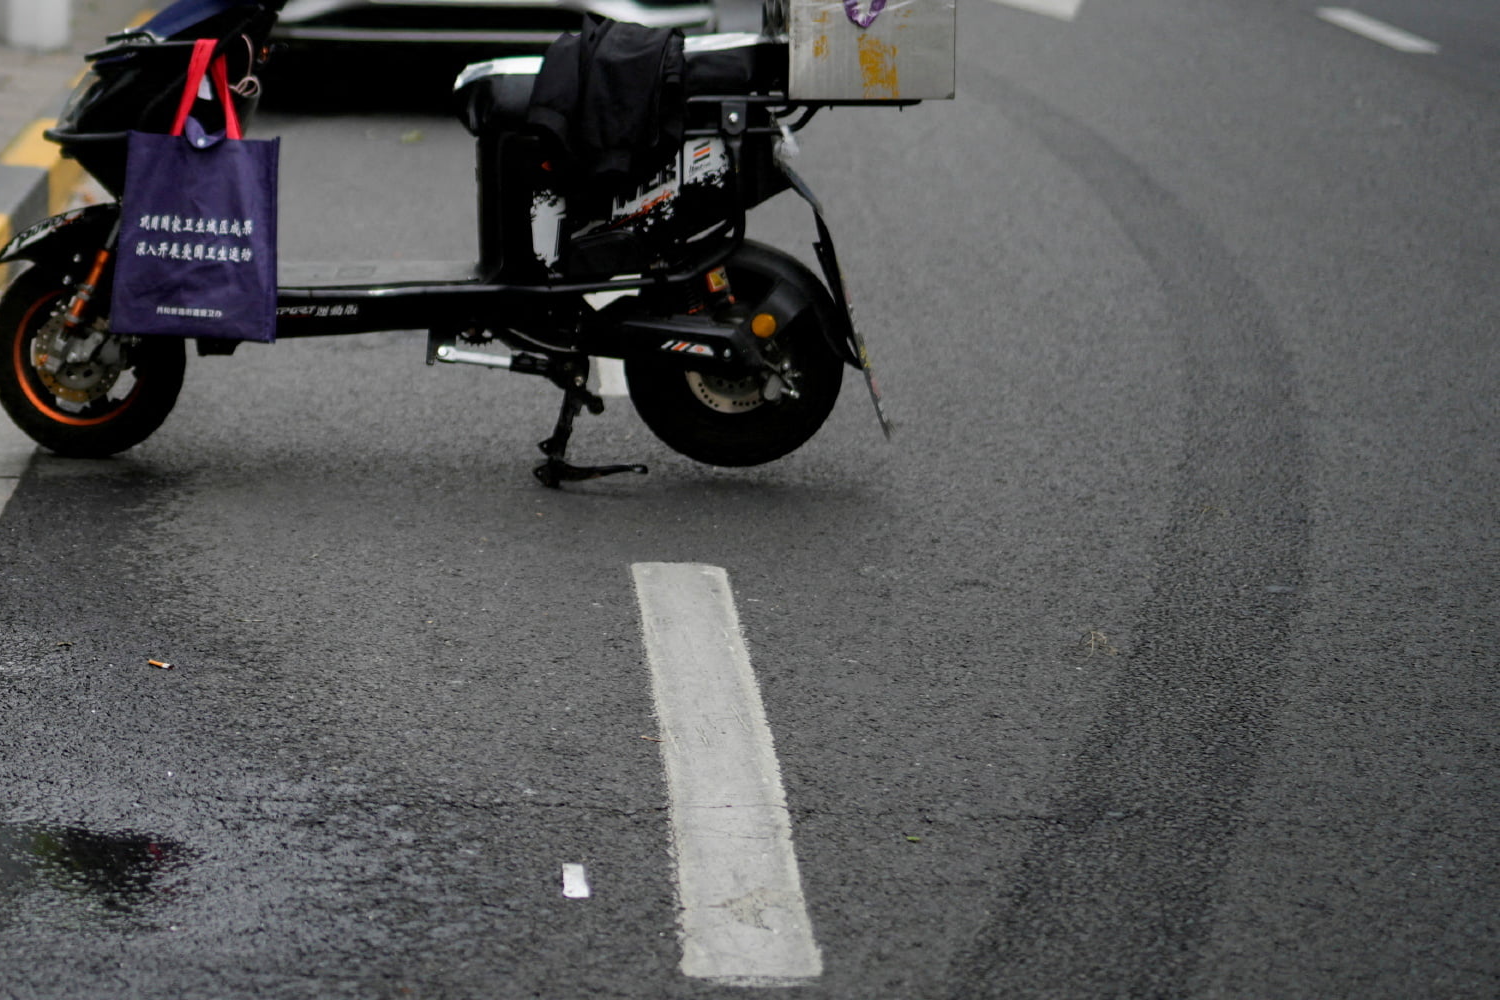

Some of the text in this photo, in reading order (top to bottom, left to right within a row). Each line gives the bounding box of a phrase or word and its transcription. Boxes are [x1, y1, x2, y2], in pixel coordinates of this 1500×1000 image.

[135, 241, 253, 263] 深入开展爱国卫生运动
